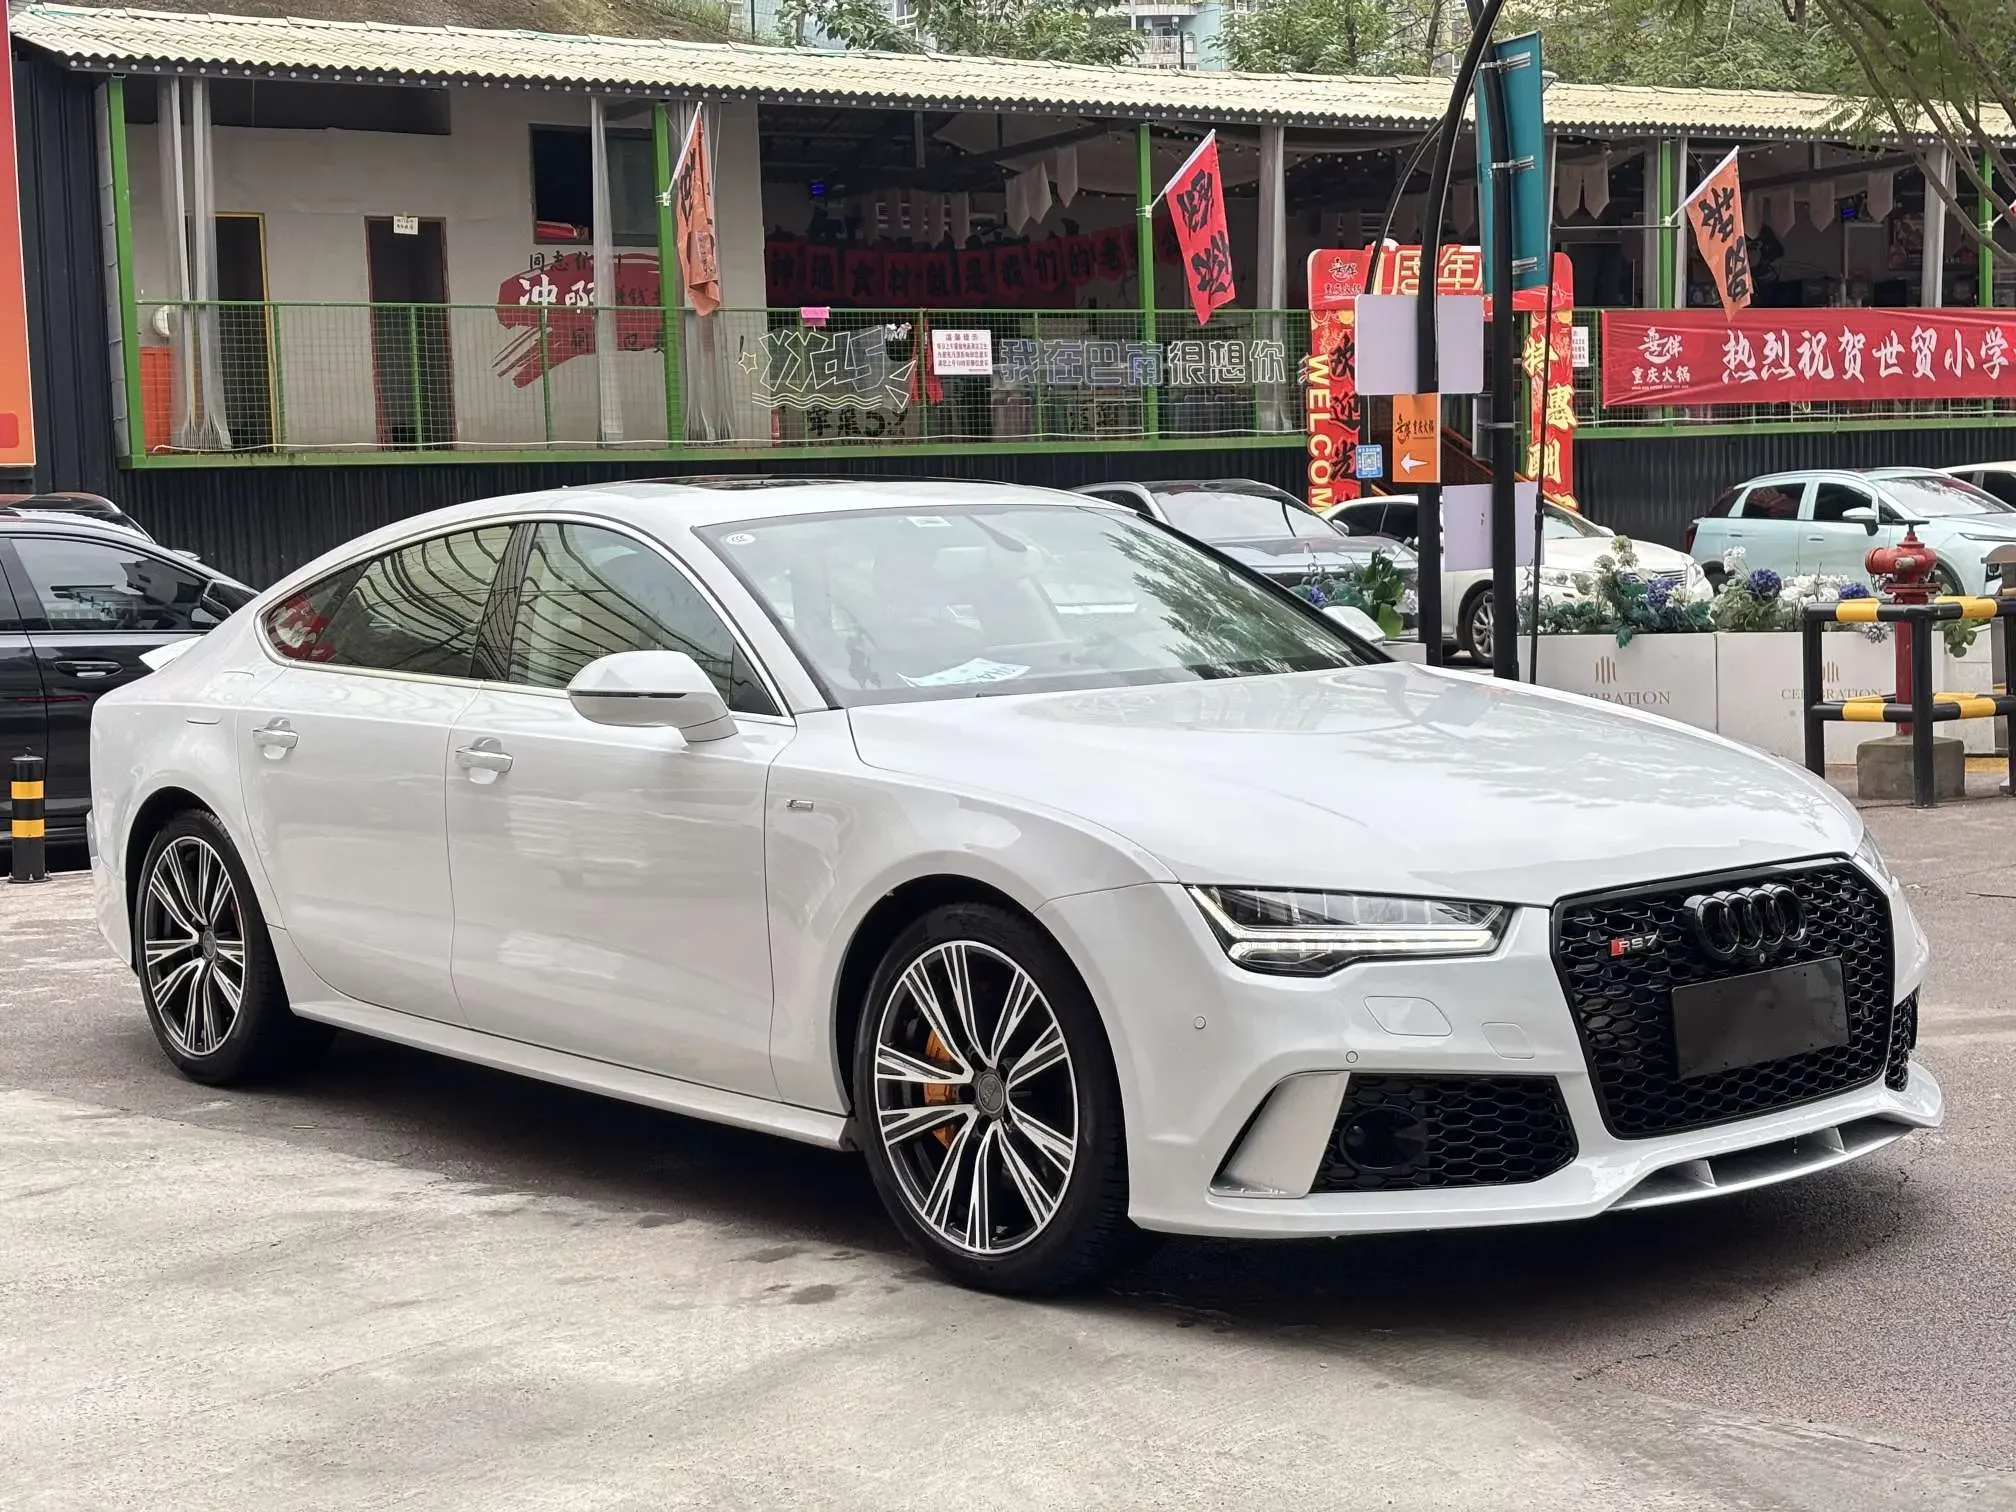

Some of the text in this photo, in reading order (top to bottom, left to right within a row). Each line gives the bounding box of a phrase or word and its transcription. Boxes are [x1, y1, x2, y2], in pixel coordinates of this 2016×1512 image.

[1001, 339, 1287, 385] 我在巴南很想你
[1631, 366, 1691, 384] 重庆火锅
[1721, 325, 2016, 384] 热烈祝贺世贸小学
[1330, 331, 1360, 503] 欢迎光
[1618, 934, 1658, 952] RS7
